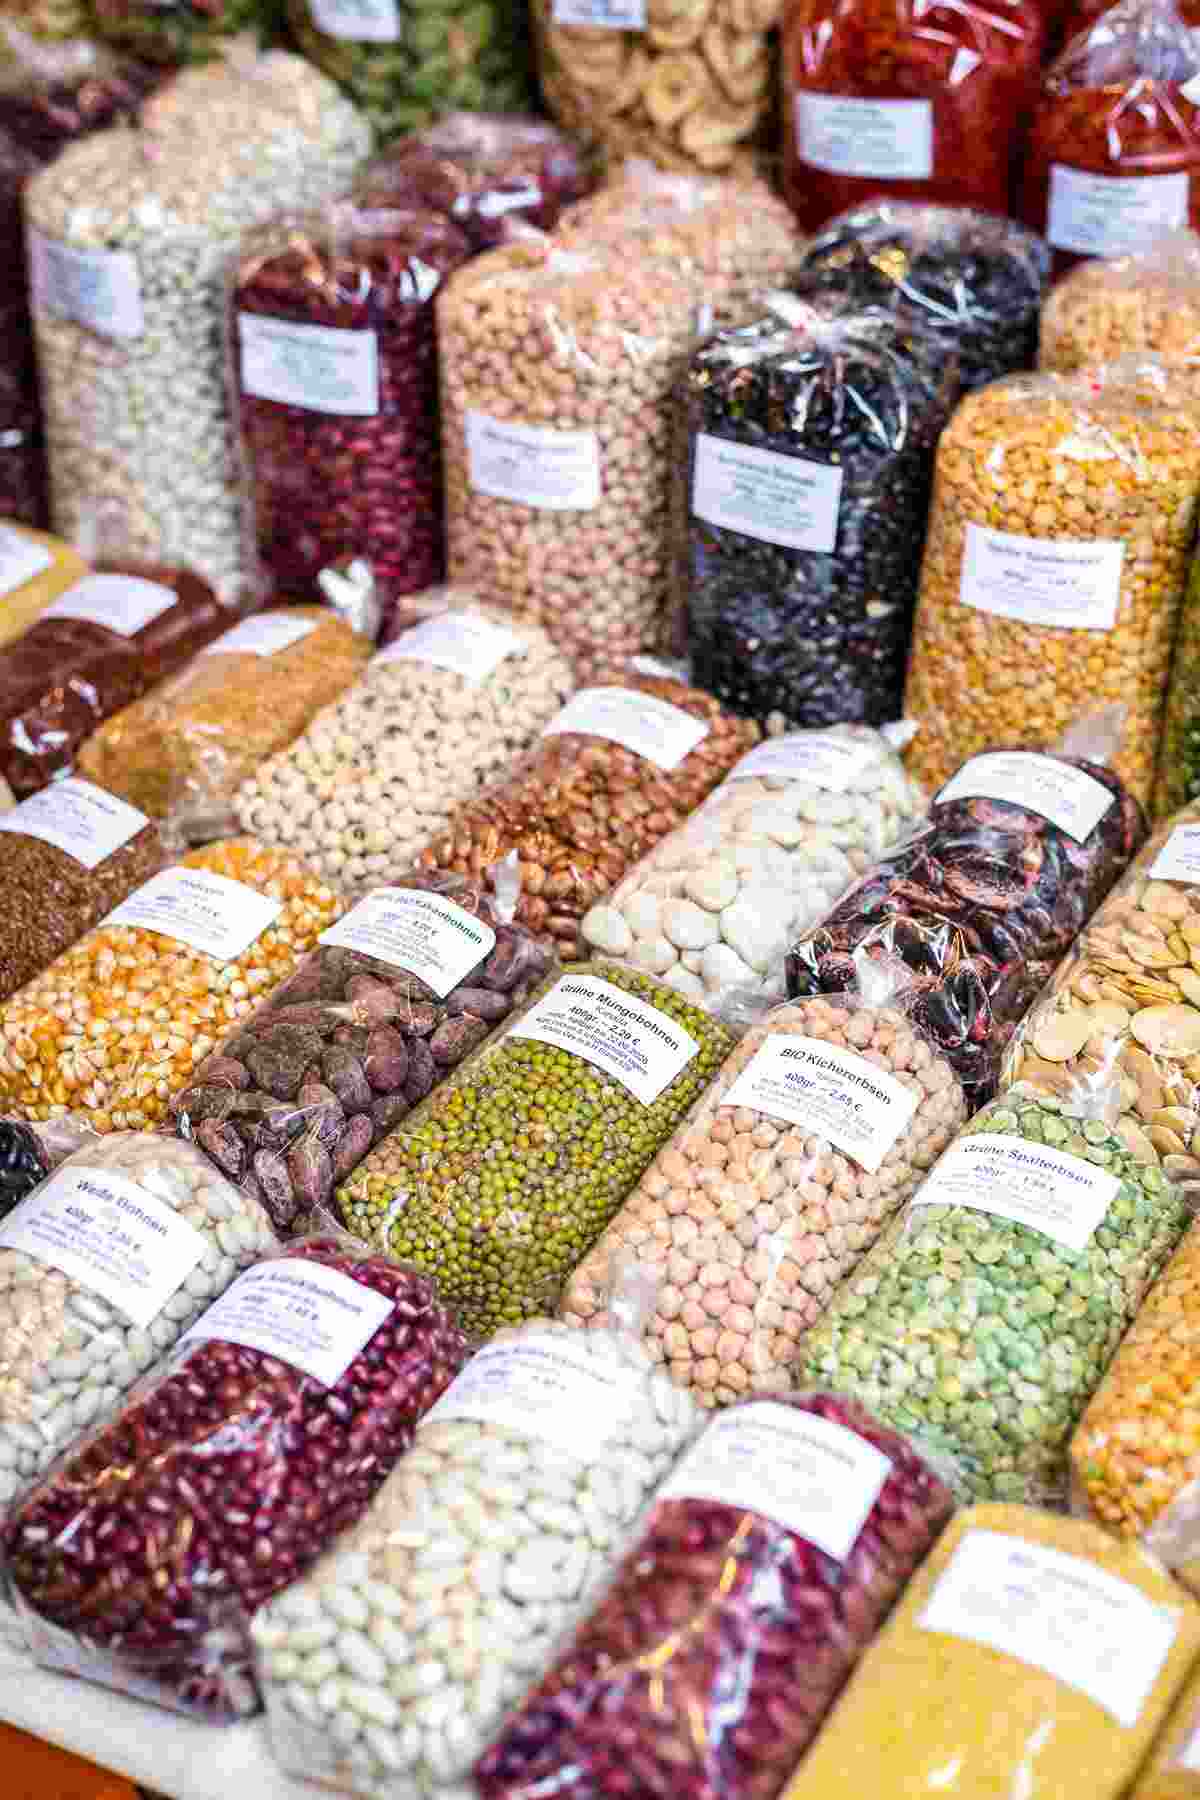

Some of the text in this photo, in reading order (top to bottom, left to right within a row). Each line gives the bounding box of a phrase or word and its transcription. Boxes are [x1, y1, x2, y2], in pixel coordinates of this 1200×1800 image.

[596, 993, 680, 1052] Mungobohnen
[631, 1037, 642, 1048] €
[780, 1048, 806, 1060] BIO
[806, 1054, 892, 1106] Kichererbsen
[854, 1102, 864, 1113] €
[1007, 1149, 1098, 1188] Spalterbsen
